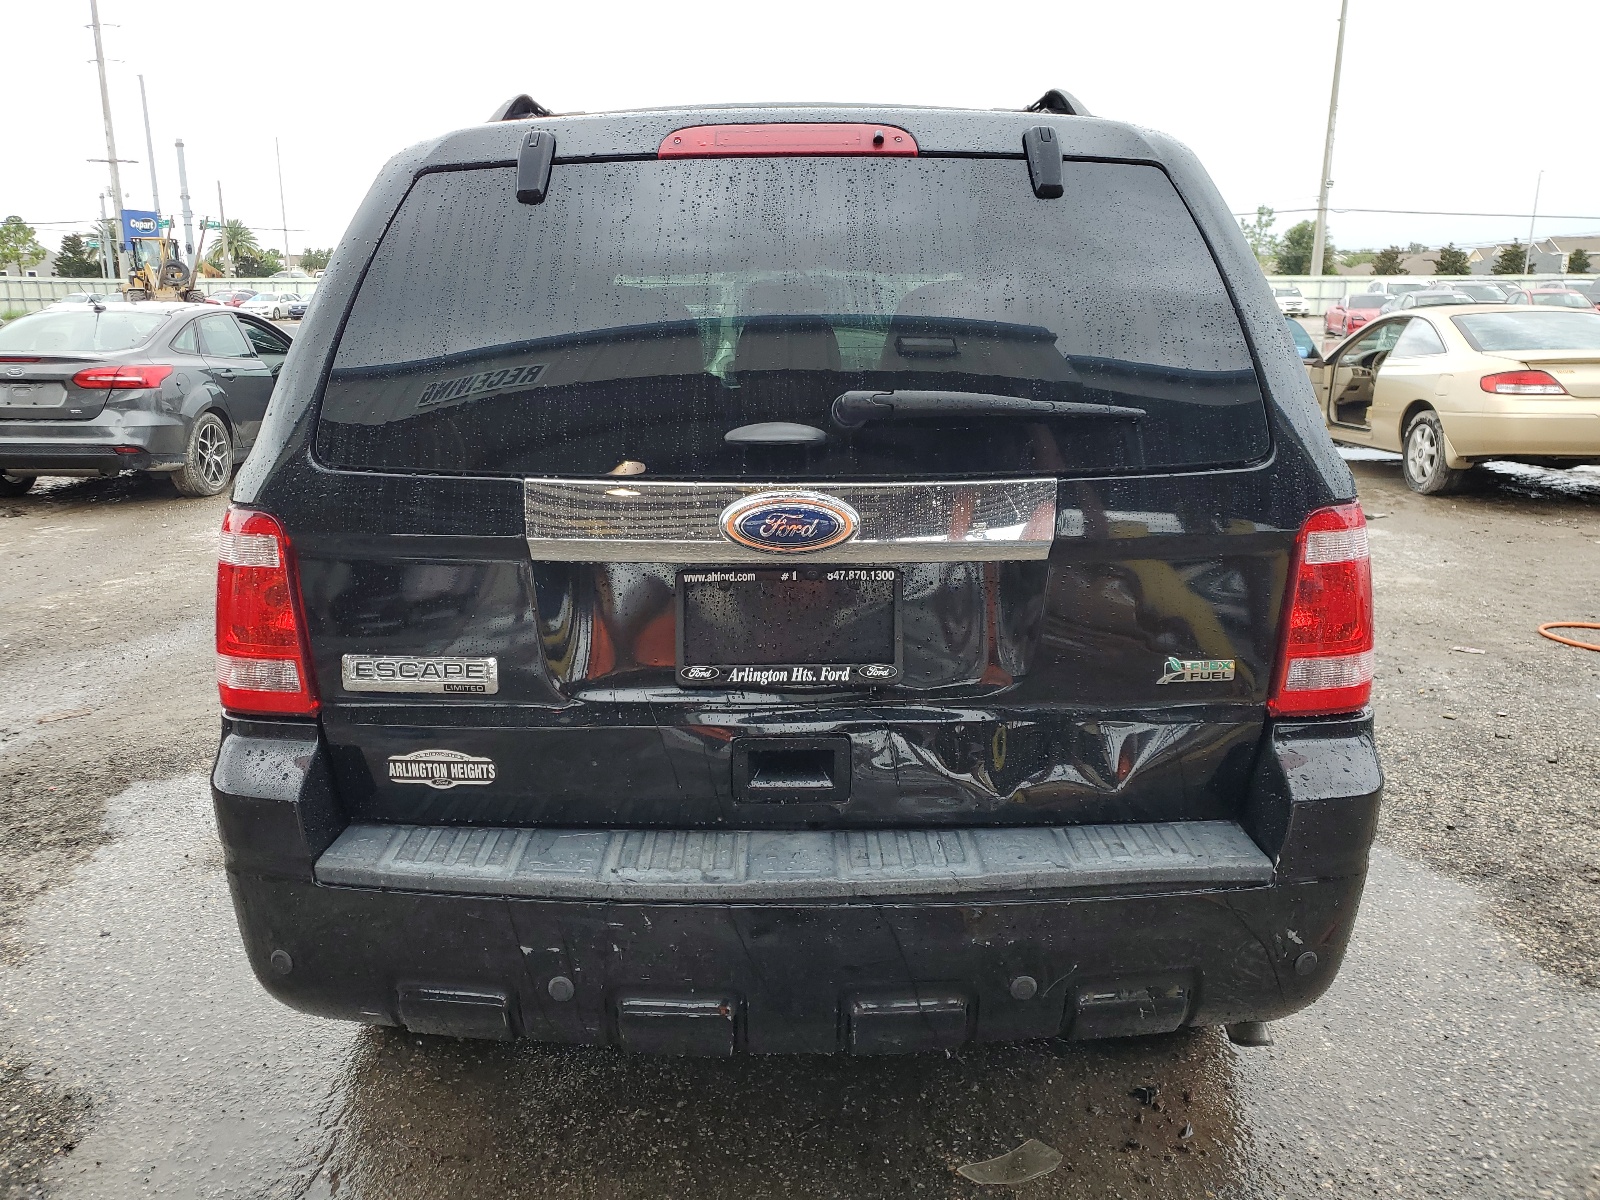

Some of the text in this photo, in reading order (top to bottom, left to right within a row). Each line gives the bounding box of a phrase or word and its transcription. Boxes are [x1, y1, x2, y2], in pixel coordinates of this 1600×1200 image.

[130, 219, 154, 230] Copart
[759, 512, 819, 538] Ford
[683, 571, 756, 583] www.ahford.com
[826, 570, 895, 581] 847.870.1300
[354, 661, 485, 679] ESCAPE
[865, 665, 890, 676] Ford
[1190, 661, 1231, 671] FLEX
[687, 666, 712, 678] Ford
[727, 667, 850, 685] Arlington Hts. Ford
[1190, 671, 1231, 680] FUEL
[445, 684, 484, 692] LIMITED
[388, 761, 496, 779] ARLINGTON HEIGHTS
